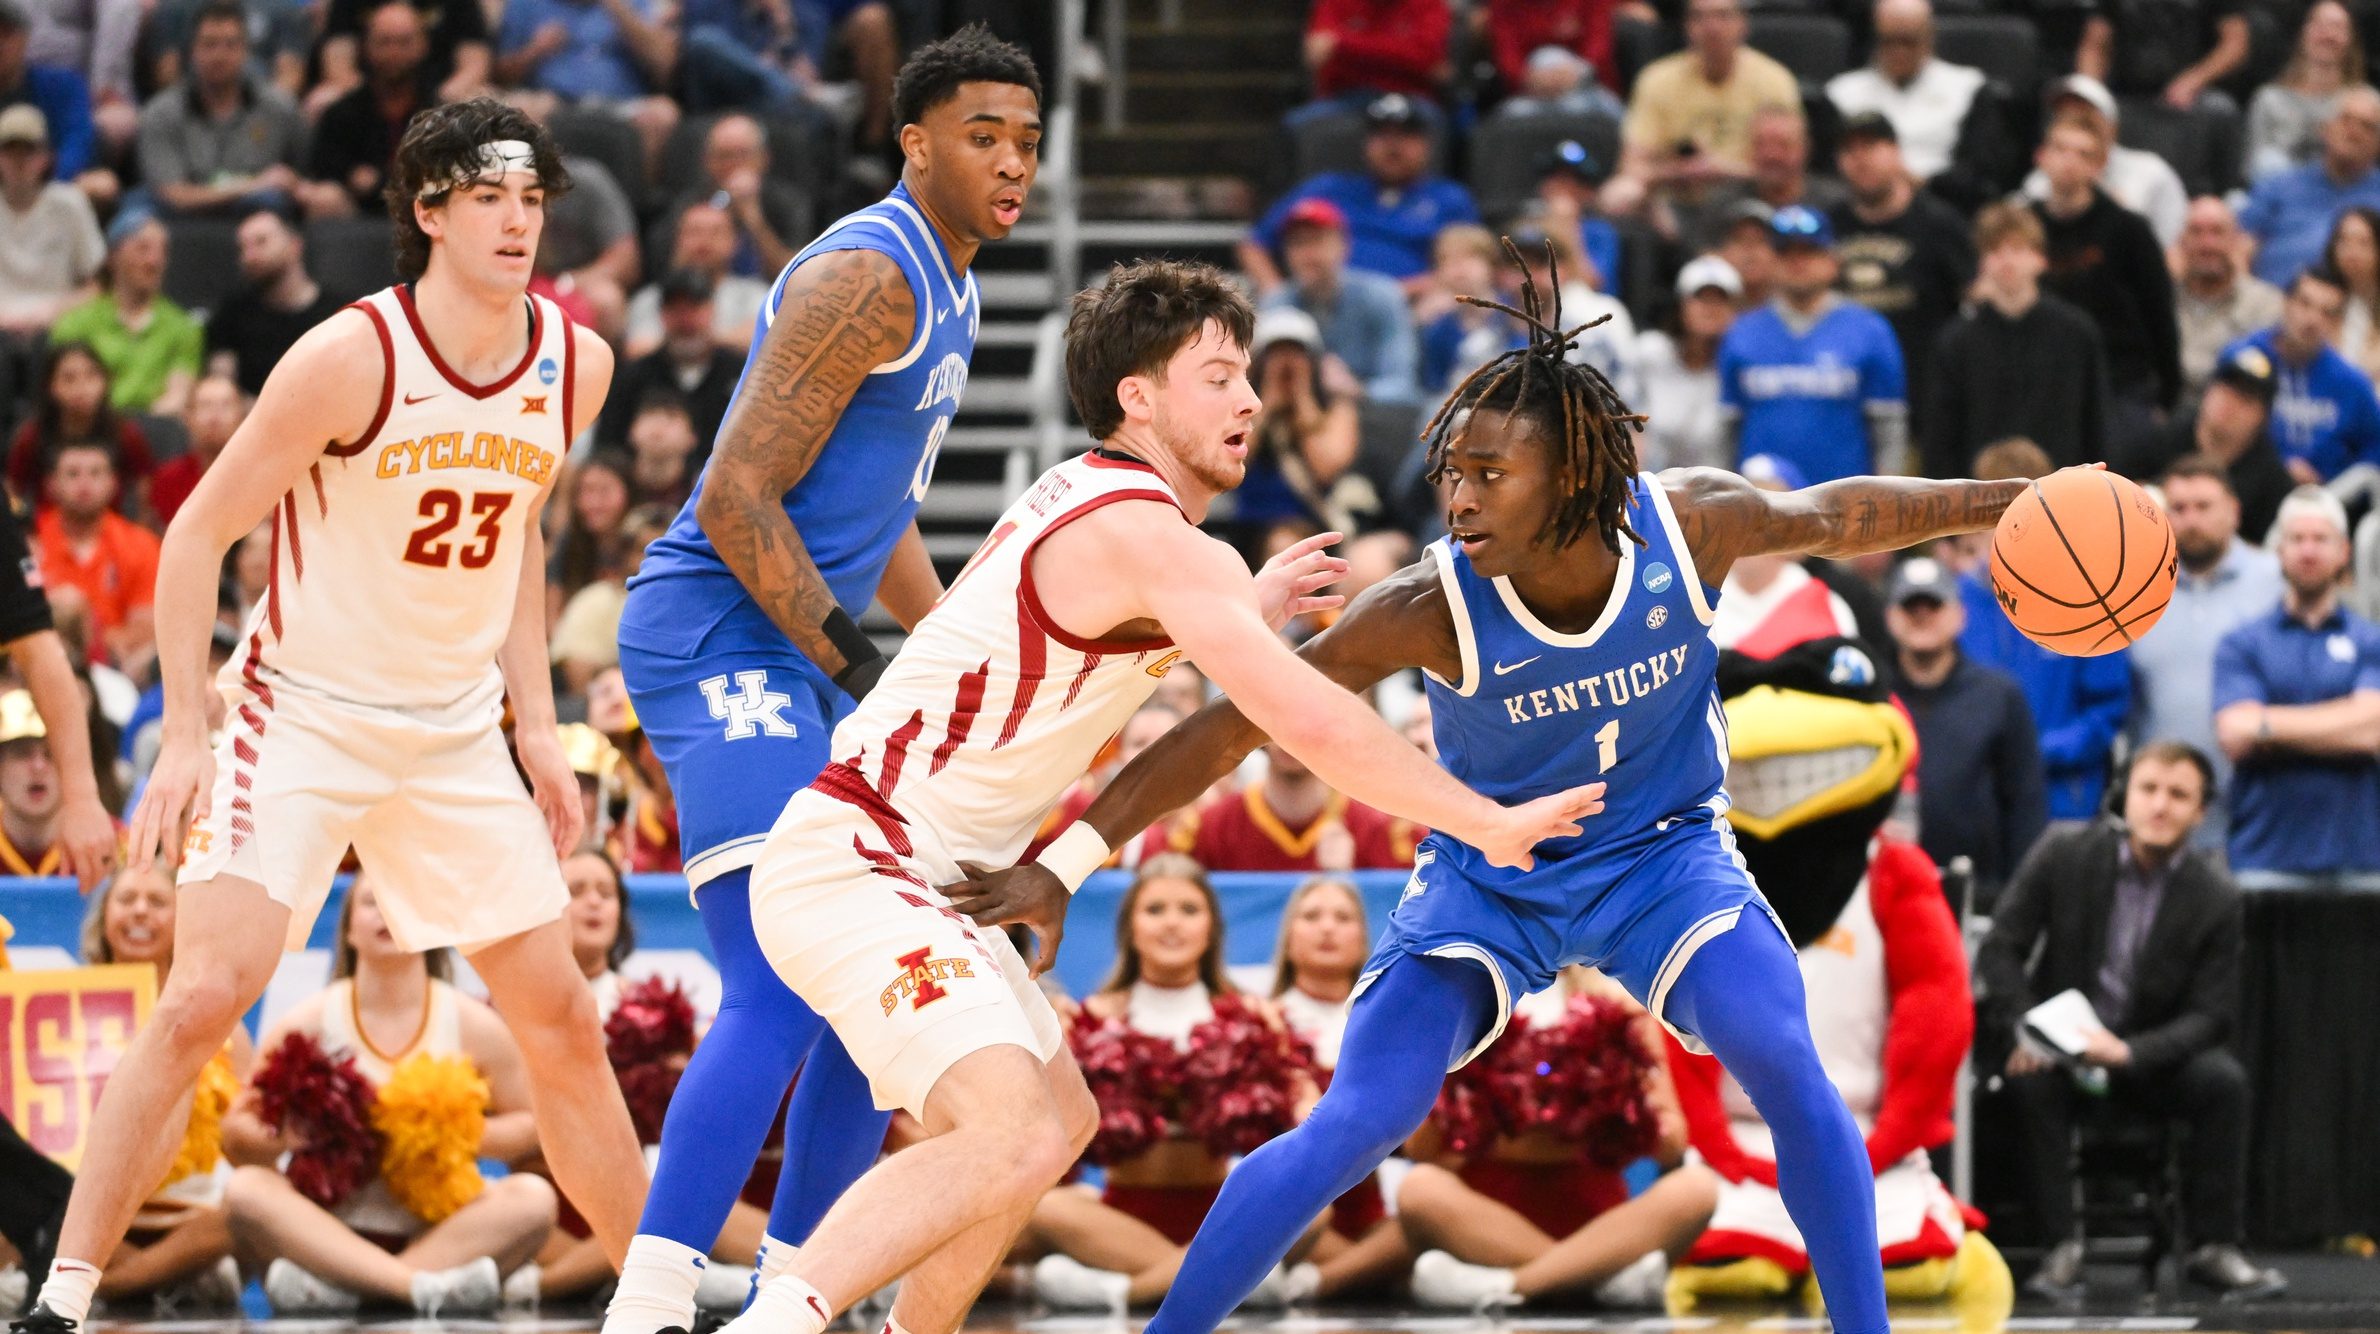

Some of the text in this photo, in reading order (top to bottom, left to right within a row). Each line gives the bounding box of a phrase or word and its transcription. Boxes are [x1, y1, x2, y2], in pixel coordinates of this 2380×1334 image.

[376, 431, 555, 487] CYCLONES
[403, 488, 514, 570] 23
[1648, 571, 1671, 590] NCAA
[1647, 606, 1667, 628] SEC
[698, 669, 798, 741] UK
[1503, 644, 1688, 724] KENTUCKY
[1594, 719, 1620, 775] 1
[880, 958, 976, 1018] STATE
[0, 988, 136, 1154] SE
